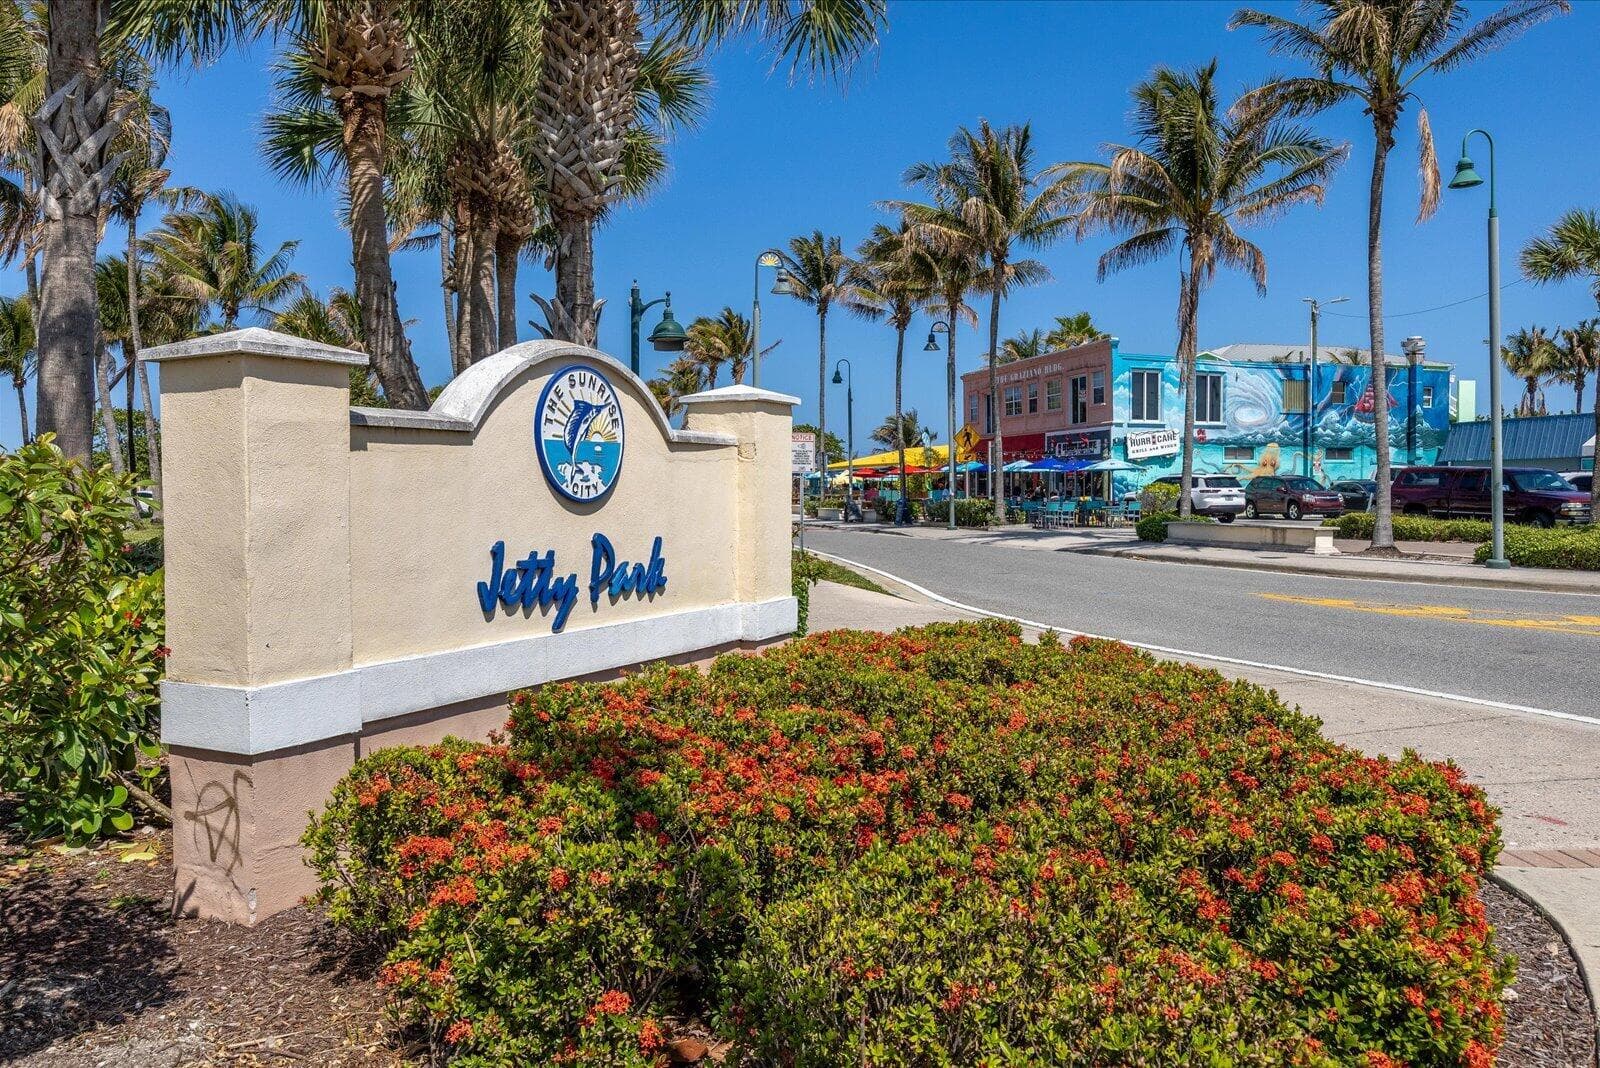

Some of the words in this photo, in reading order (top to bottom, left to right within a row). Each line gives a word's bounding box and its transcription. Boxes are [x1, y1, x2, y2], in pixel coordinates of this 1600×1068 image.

[544, 385, 564, 426] THE
[568, 372, 620, 430] SUNRISE
[572, 481, 599, 498] CITY
[477, 540, 580, 634] Jetty
[589, 532, 668, 604] Park
